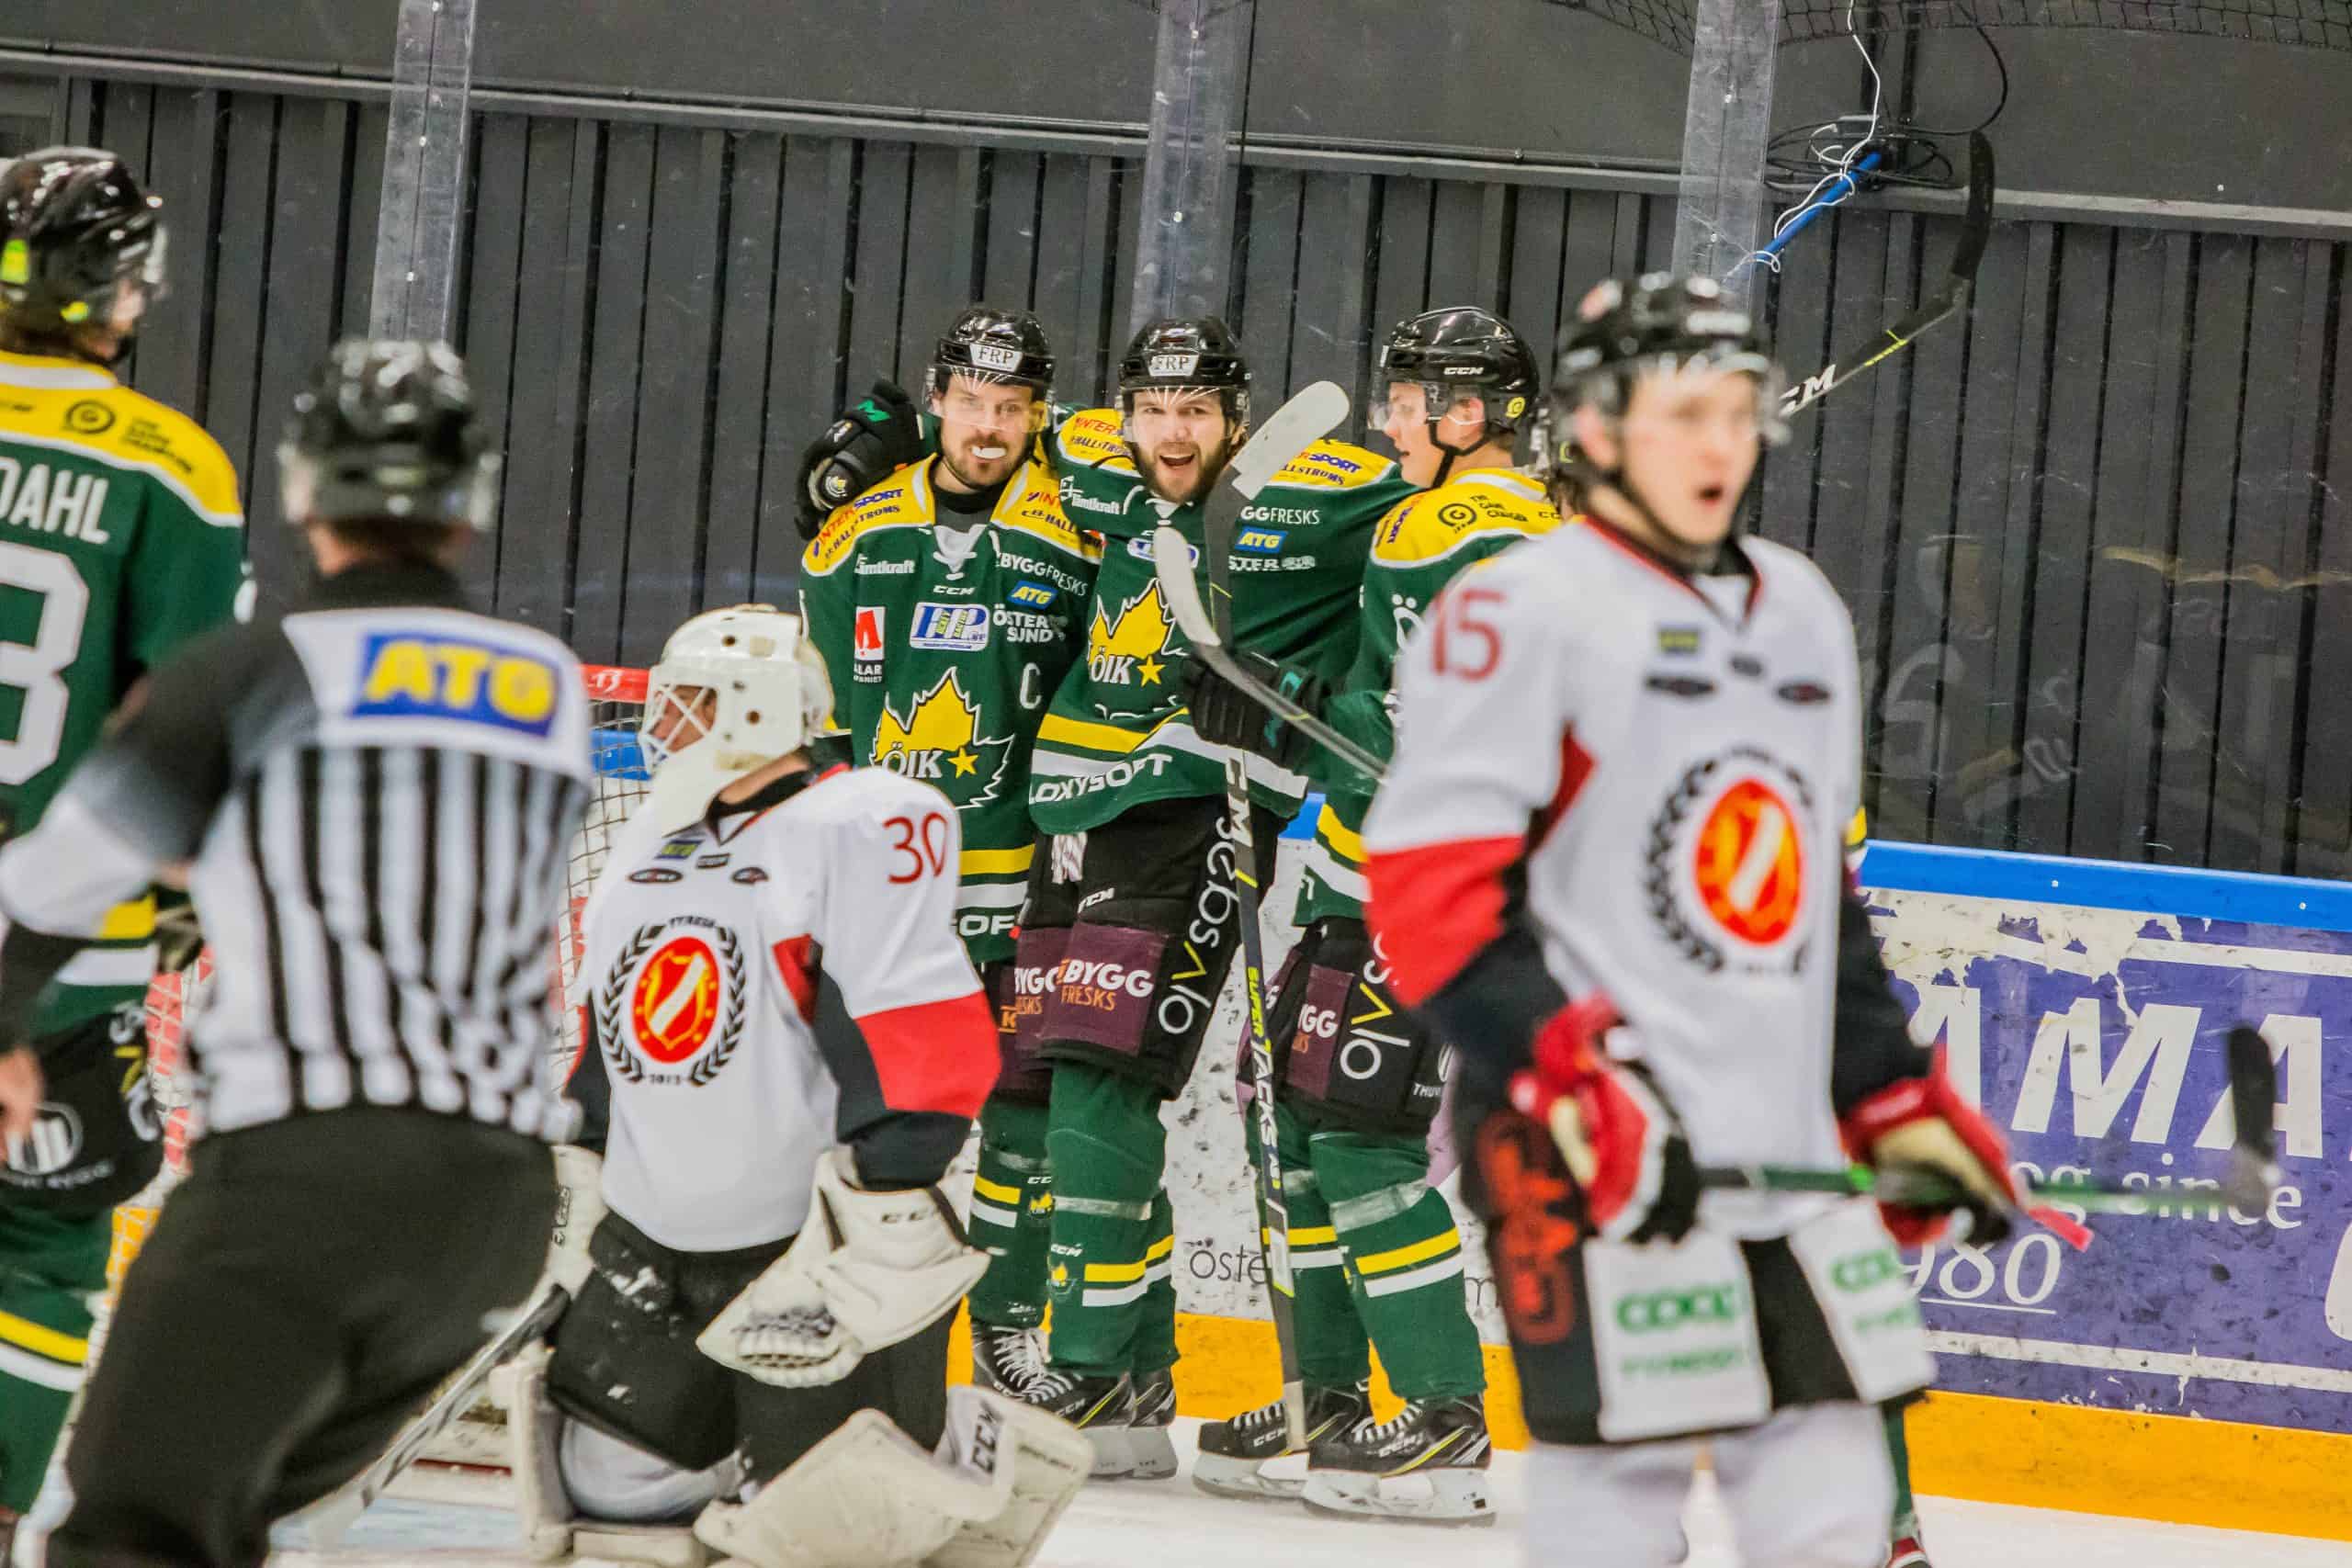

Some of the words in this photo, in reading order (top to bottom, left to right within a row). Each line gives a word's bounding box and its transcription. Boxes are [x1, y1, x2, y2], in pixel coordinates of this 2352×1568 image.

[977, 345, 1014, 365] FRP
[1443, 366, 1485, 376] CCM
[1238, 531, 1283, 549] ATG
[933, 584, 977, 596] CCM
[1011, 586, 1053, 604] ATG
[1090, 646, 1136, 685] ÖIK
[1018, 661, 1043, 710] C
[881, 741, 944, 779] ÖIK
[882, 811, 949, 885] 30
[1061, 985, 1117, 1011] FRESKS
